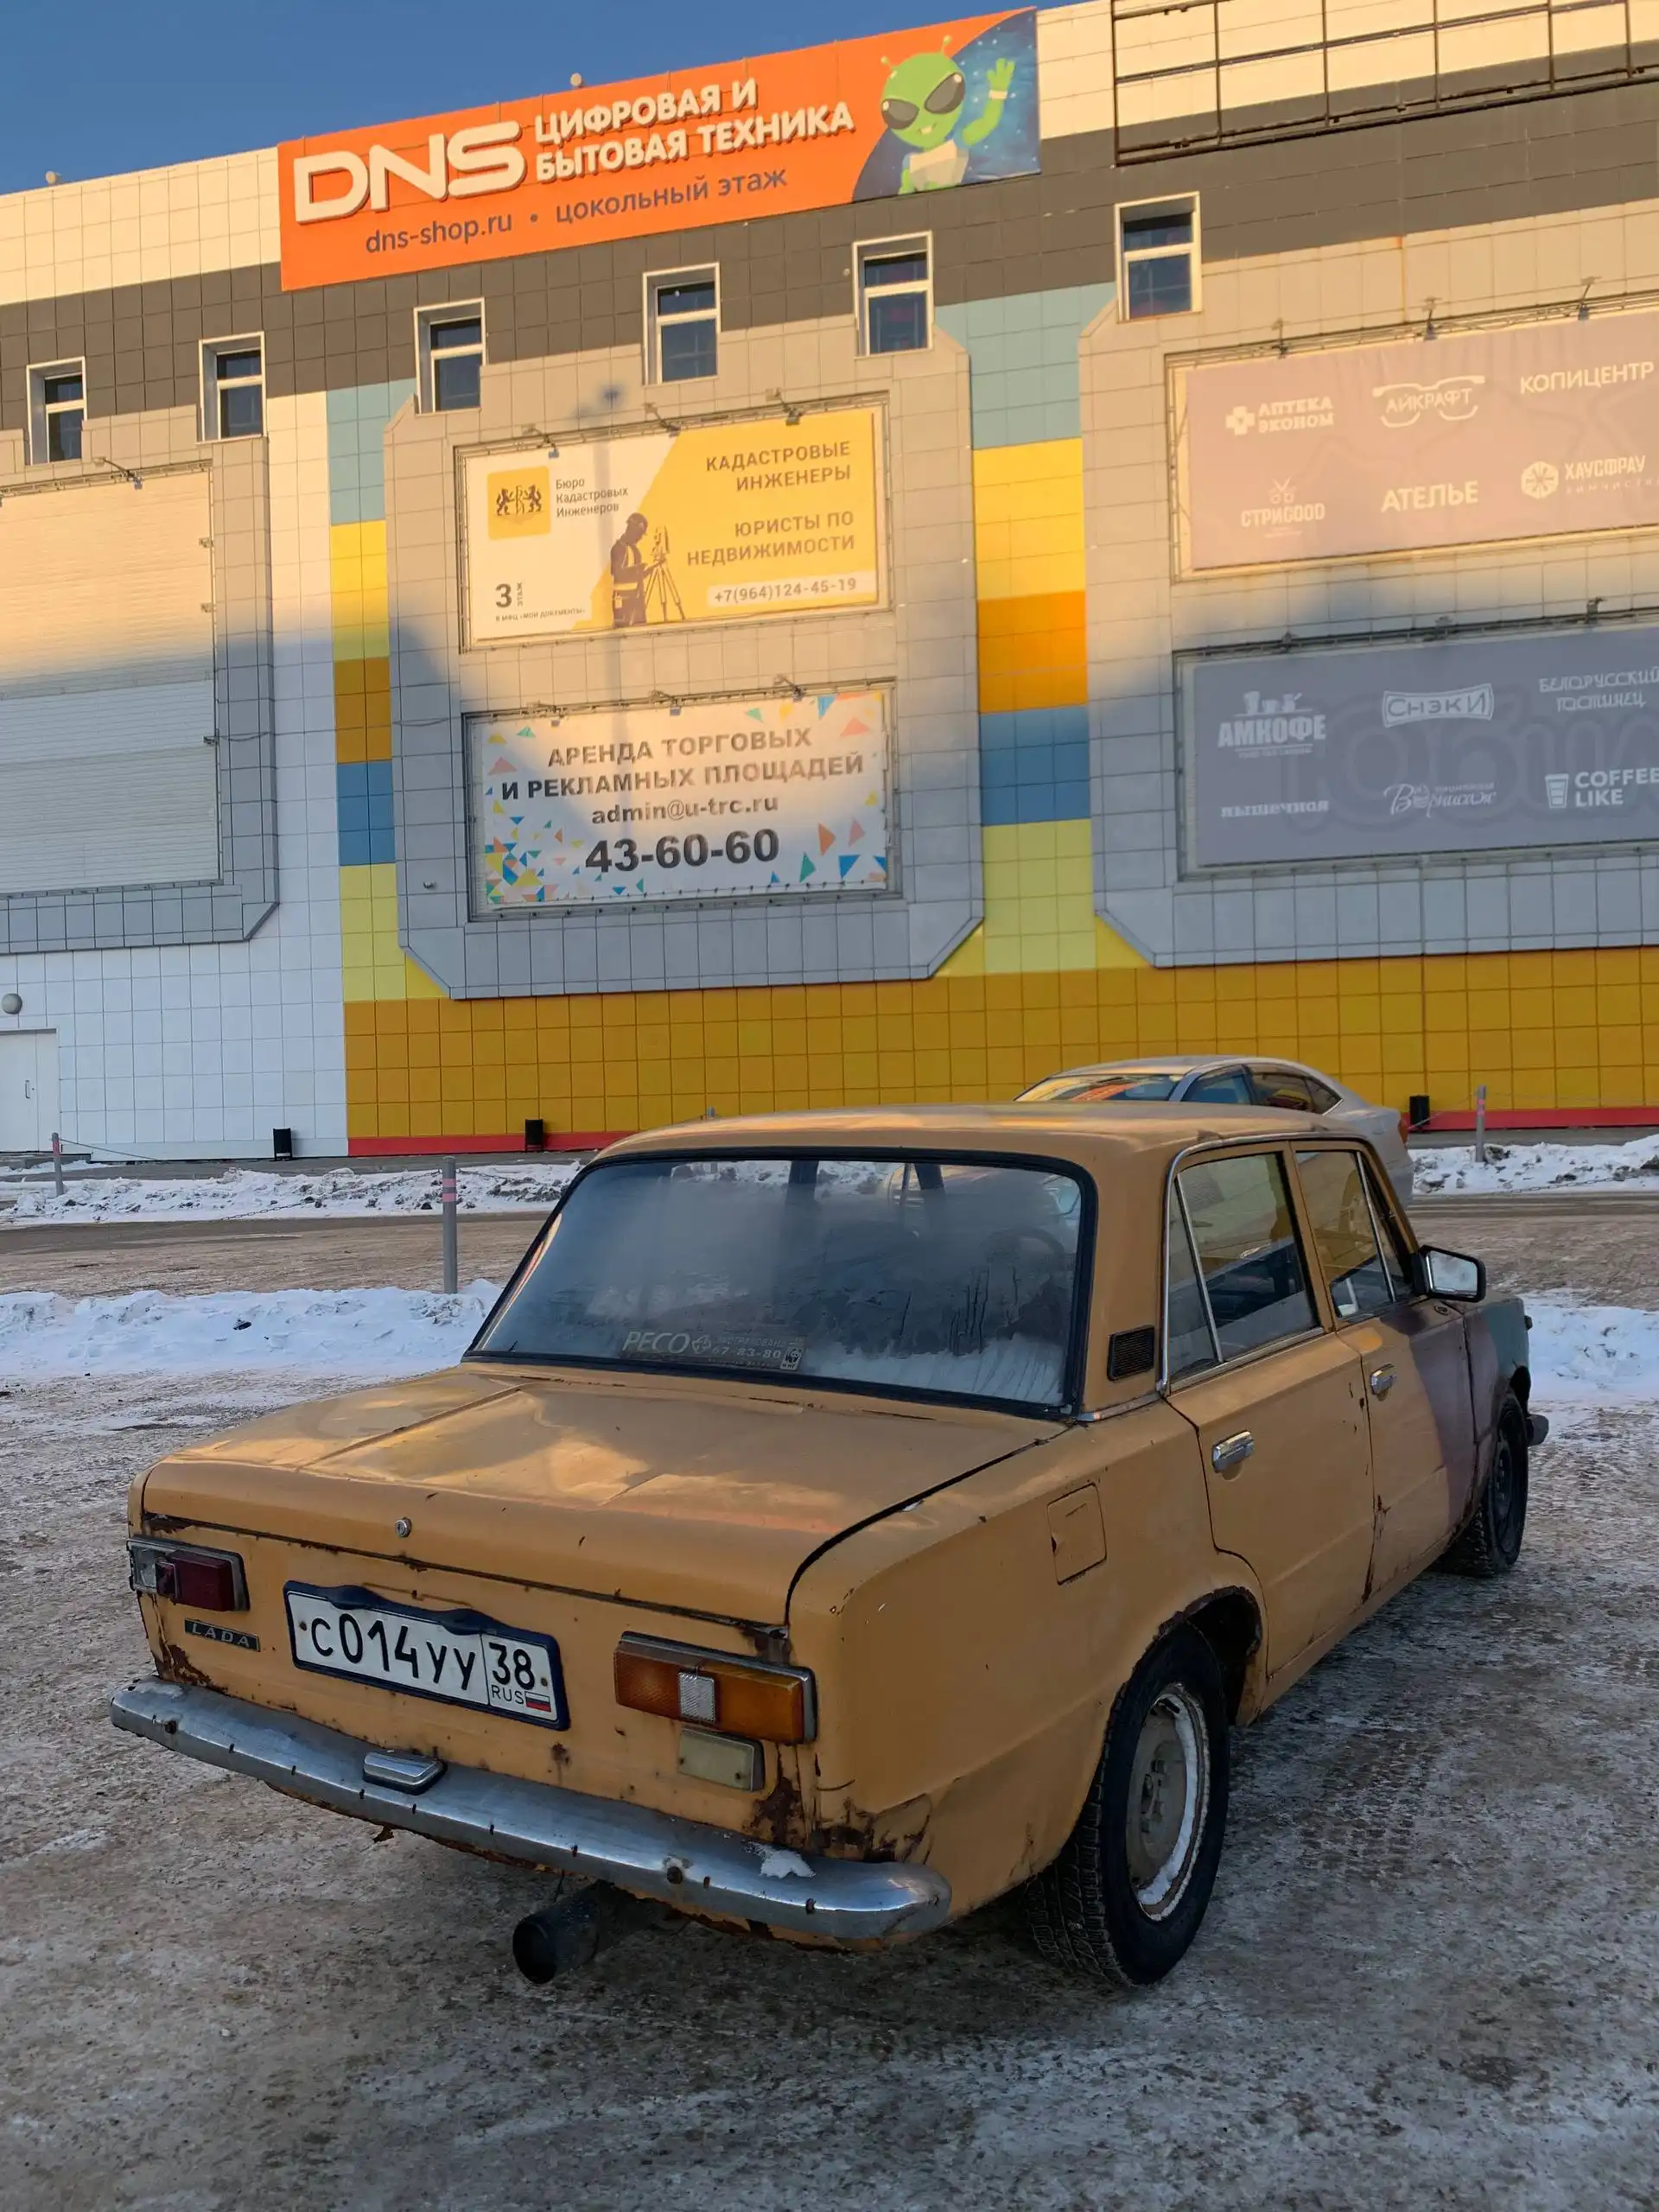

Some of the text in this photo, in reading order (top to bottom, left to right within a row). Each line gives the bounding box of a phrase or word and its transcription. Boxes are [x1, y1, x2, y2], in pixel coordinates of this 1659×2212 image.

[535, 78, 758, 145] ЦИФРОВАЯ И
[536, 101, 855, 182] БЫТОВАЯ ТЕХНИКА
[294, 120, 527, 224] DNS
[365, 168, 788, 253] dns-shop.ru цокольный этаж
[1520, 362, 1654, 395] КОПИЦЕНТР
[1258, 396, 1333, 416] АПТЕКА
[1386, 388, 1472, 415] АЙКРАФТ
[1258, 411, 1334, 434] ЭКОНОМ
[707, 441, 851, 472] КАДАСТРОВЫЕ
[1565, 454, 1645, 480] ХАУСФРАУ
[556, 478, 585, 491] Бюро
[736, 465, 851, 493] ИНЖЕНЕРЫ
[556, 487, 629, 505] Кадастровых
[1381, 480, 1478, 512] АТЕЛЬЕ
[556, 503, 619, 518] Инженеров
[735, 511, 855, 537] ЮРИСТЫ ПО
[687, 534, 855, 567] НЕДВИЖИМОСТИ
[495, 583, 512, 608] 3
[714, 577, 857, 603] +7(964)124-45-19
[1388, 694, 1486, 718] СНЭКИ
[548, 728, 811, 767] АРЕНДА ТОРГОВЫХ
[501, 753, 864, 800] И РЕКЛАМНЫХ ПЛОЩАДЕЙ
[592, 795, 779, 824] admin@u-trc.ru
[1575, 789, 1624, 807] LIKE
[585, 829, 779, 873] 43-60-60
[190, 1623, 252, 1648] LADA
[488, 1643, 535, 1689] 38
[491, 1684, 524, 1705] RUS
